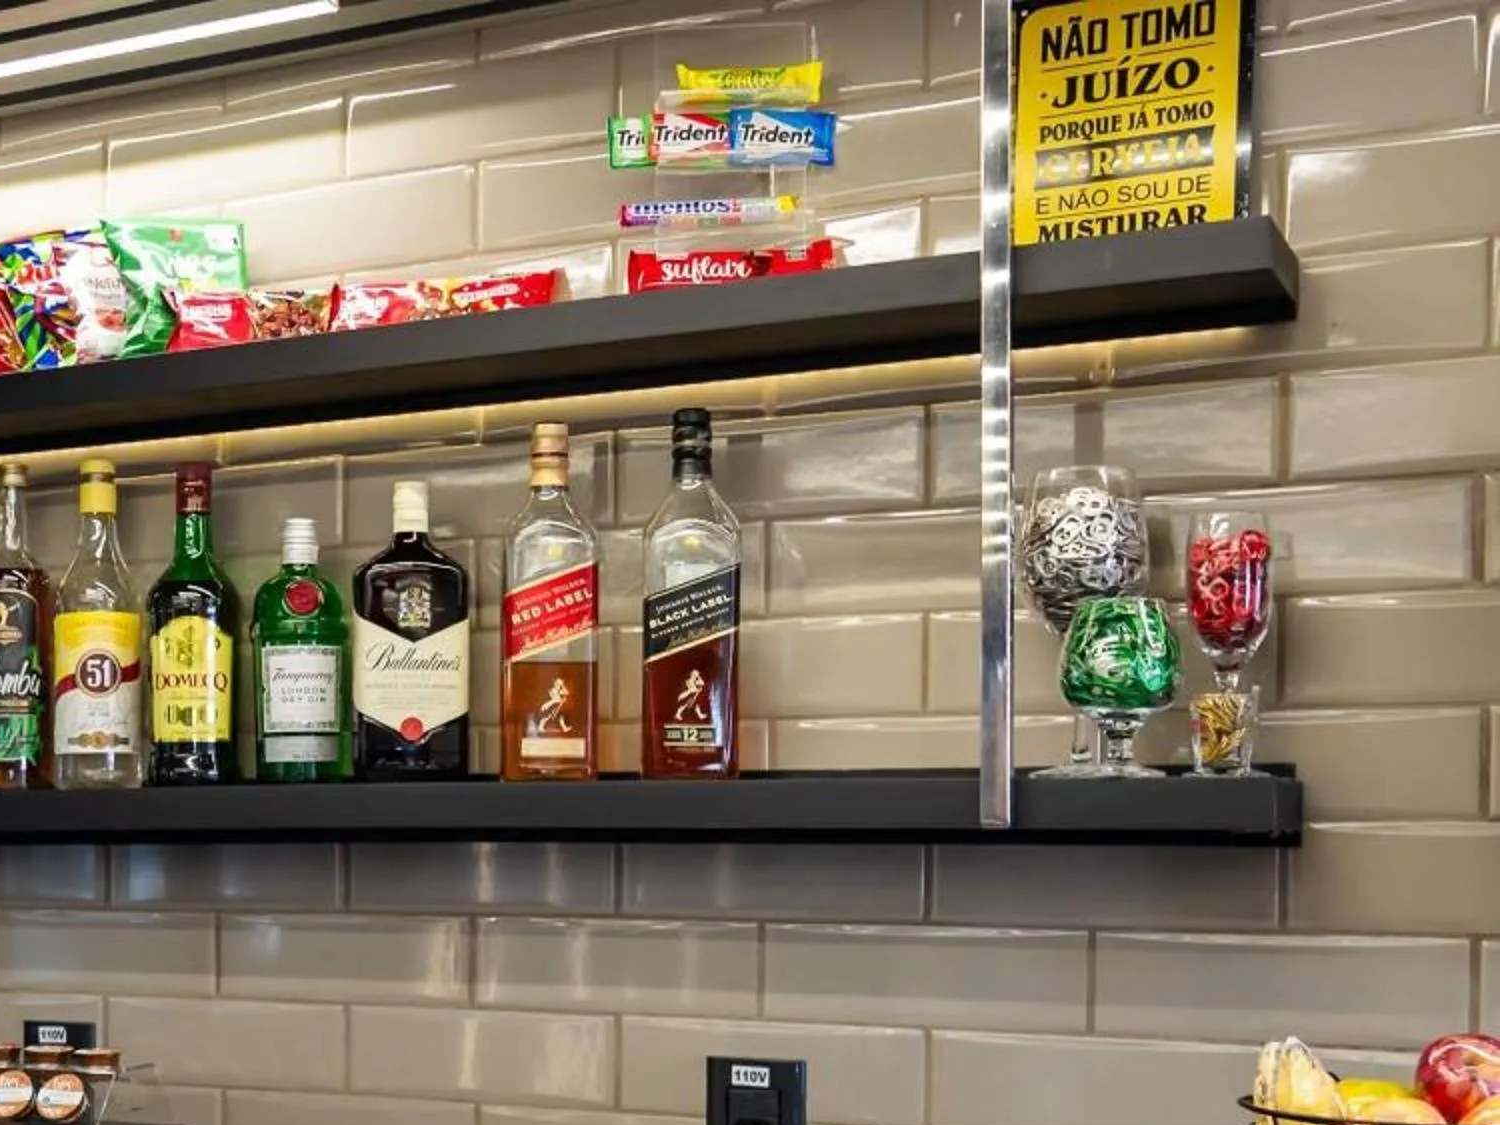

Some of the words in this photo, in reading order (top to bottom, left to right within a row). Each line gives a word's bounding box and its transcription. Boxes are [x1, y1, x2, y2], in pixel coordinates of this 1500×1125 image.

[1041, 16, 1109, 64] NÃO
[1121, 0, 1216, 49] TOMO
[1052, 55, 1200, 108] JUÍZO
[654, 124, 726, 142] Trident
[742, 124, 813, 144] Trident
[1040, 114, 1123, 143] PORQUE
[1127, 104, 1149, 130] JÁ
[1155, 100, 1215, 125] TOMO
[1043, 134, 1202, 181] CERVEJA
[633, 199, 730, 214] mentos
[1036, 197, 1048, 215] E
[1059, 186, 1109, 211] NÃO
[1118, 179, 1169, 203] SOU
[1178, 174, 1211, 195] DE
[1038, 204, 1207, 243] MISTURAR
[661, 256, 752, 284] suflair
[511, 606, 541, 625] RED
[545, 588, 593, 613] LABEL
[649, 608, 689, 628] BLACK
[691, 594, 733, 613] LABEL
[87, 659, 112, 688] 51
[155, 671, 229, 693] DOMECQ
[683, 729, 699, 741] 12
[733, 1069, 767, 1083] 110V
